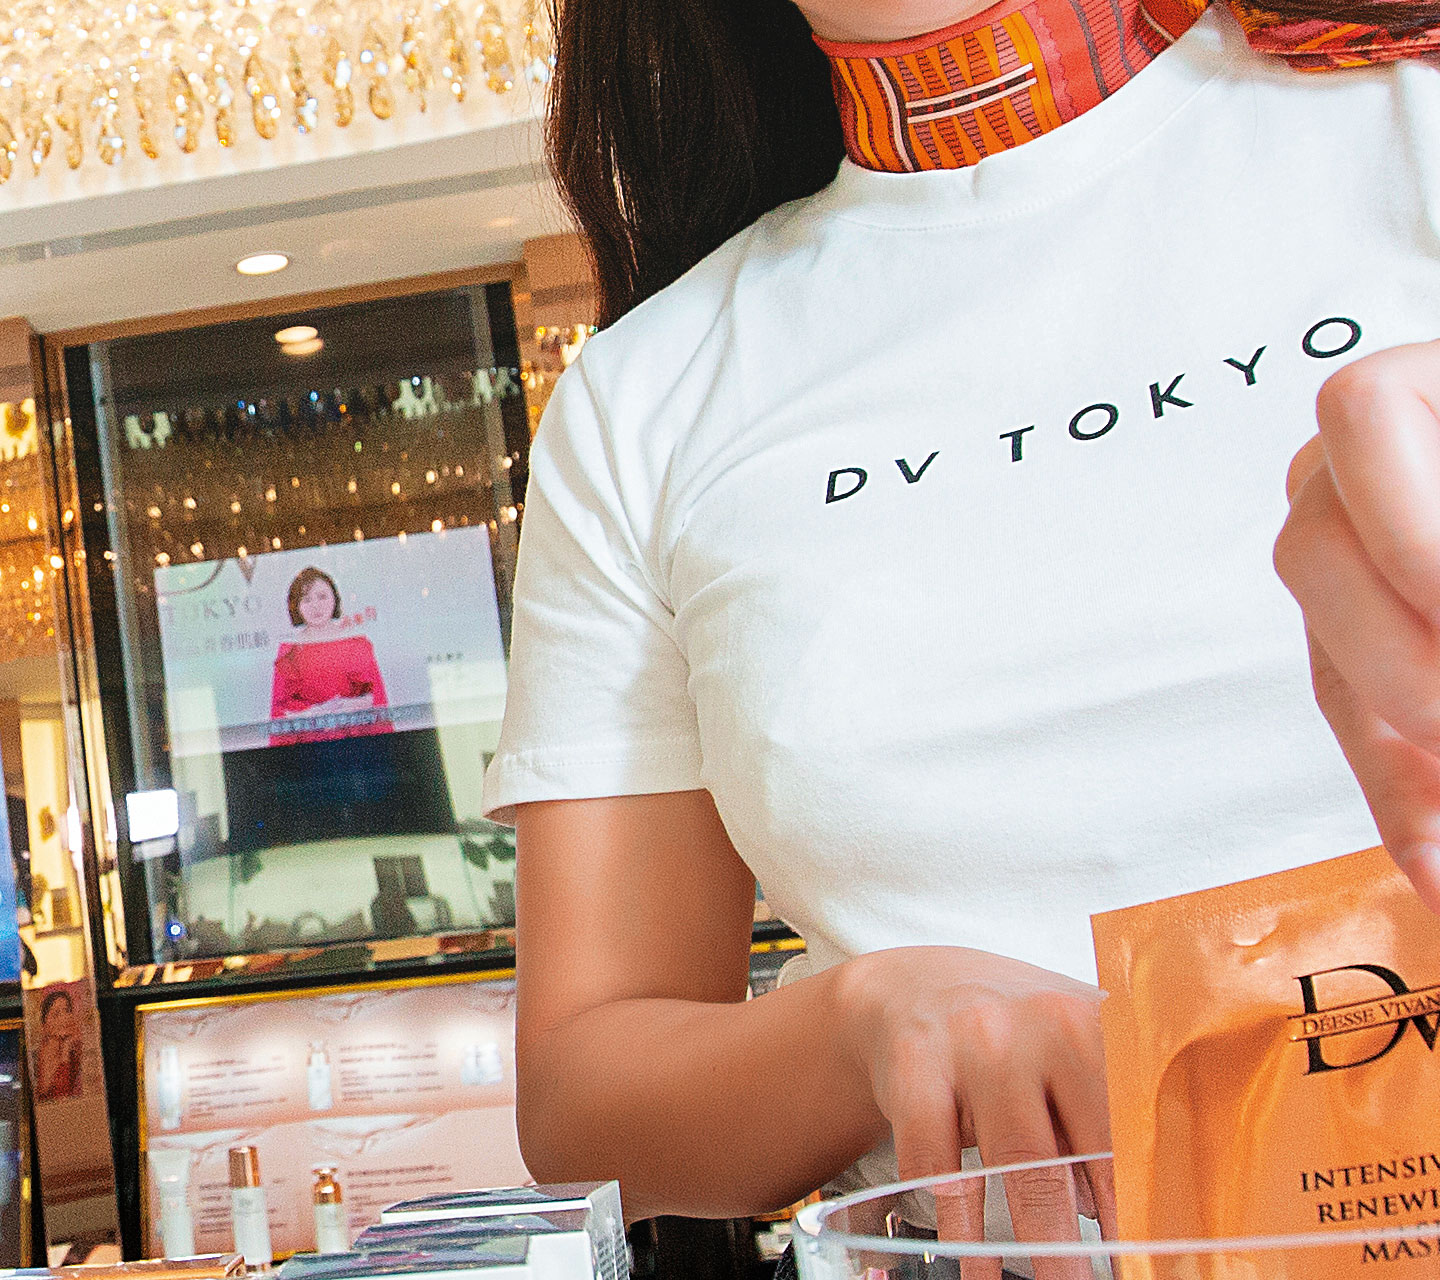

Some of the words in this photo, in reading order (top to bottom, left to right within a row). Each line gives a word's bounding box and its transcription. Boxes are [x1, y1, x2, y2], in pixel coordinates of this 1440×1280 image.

[825, 451, 939, 504] DV
[1000, 317, 1362, 463] TOKYO
[1302, 1008, 1376, 1037] DÉESSE
